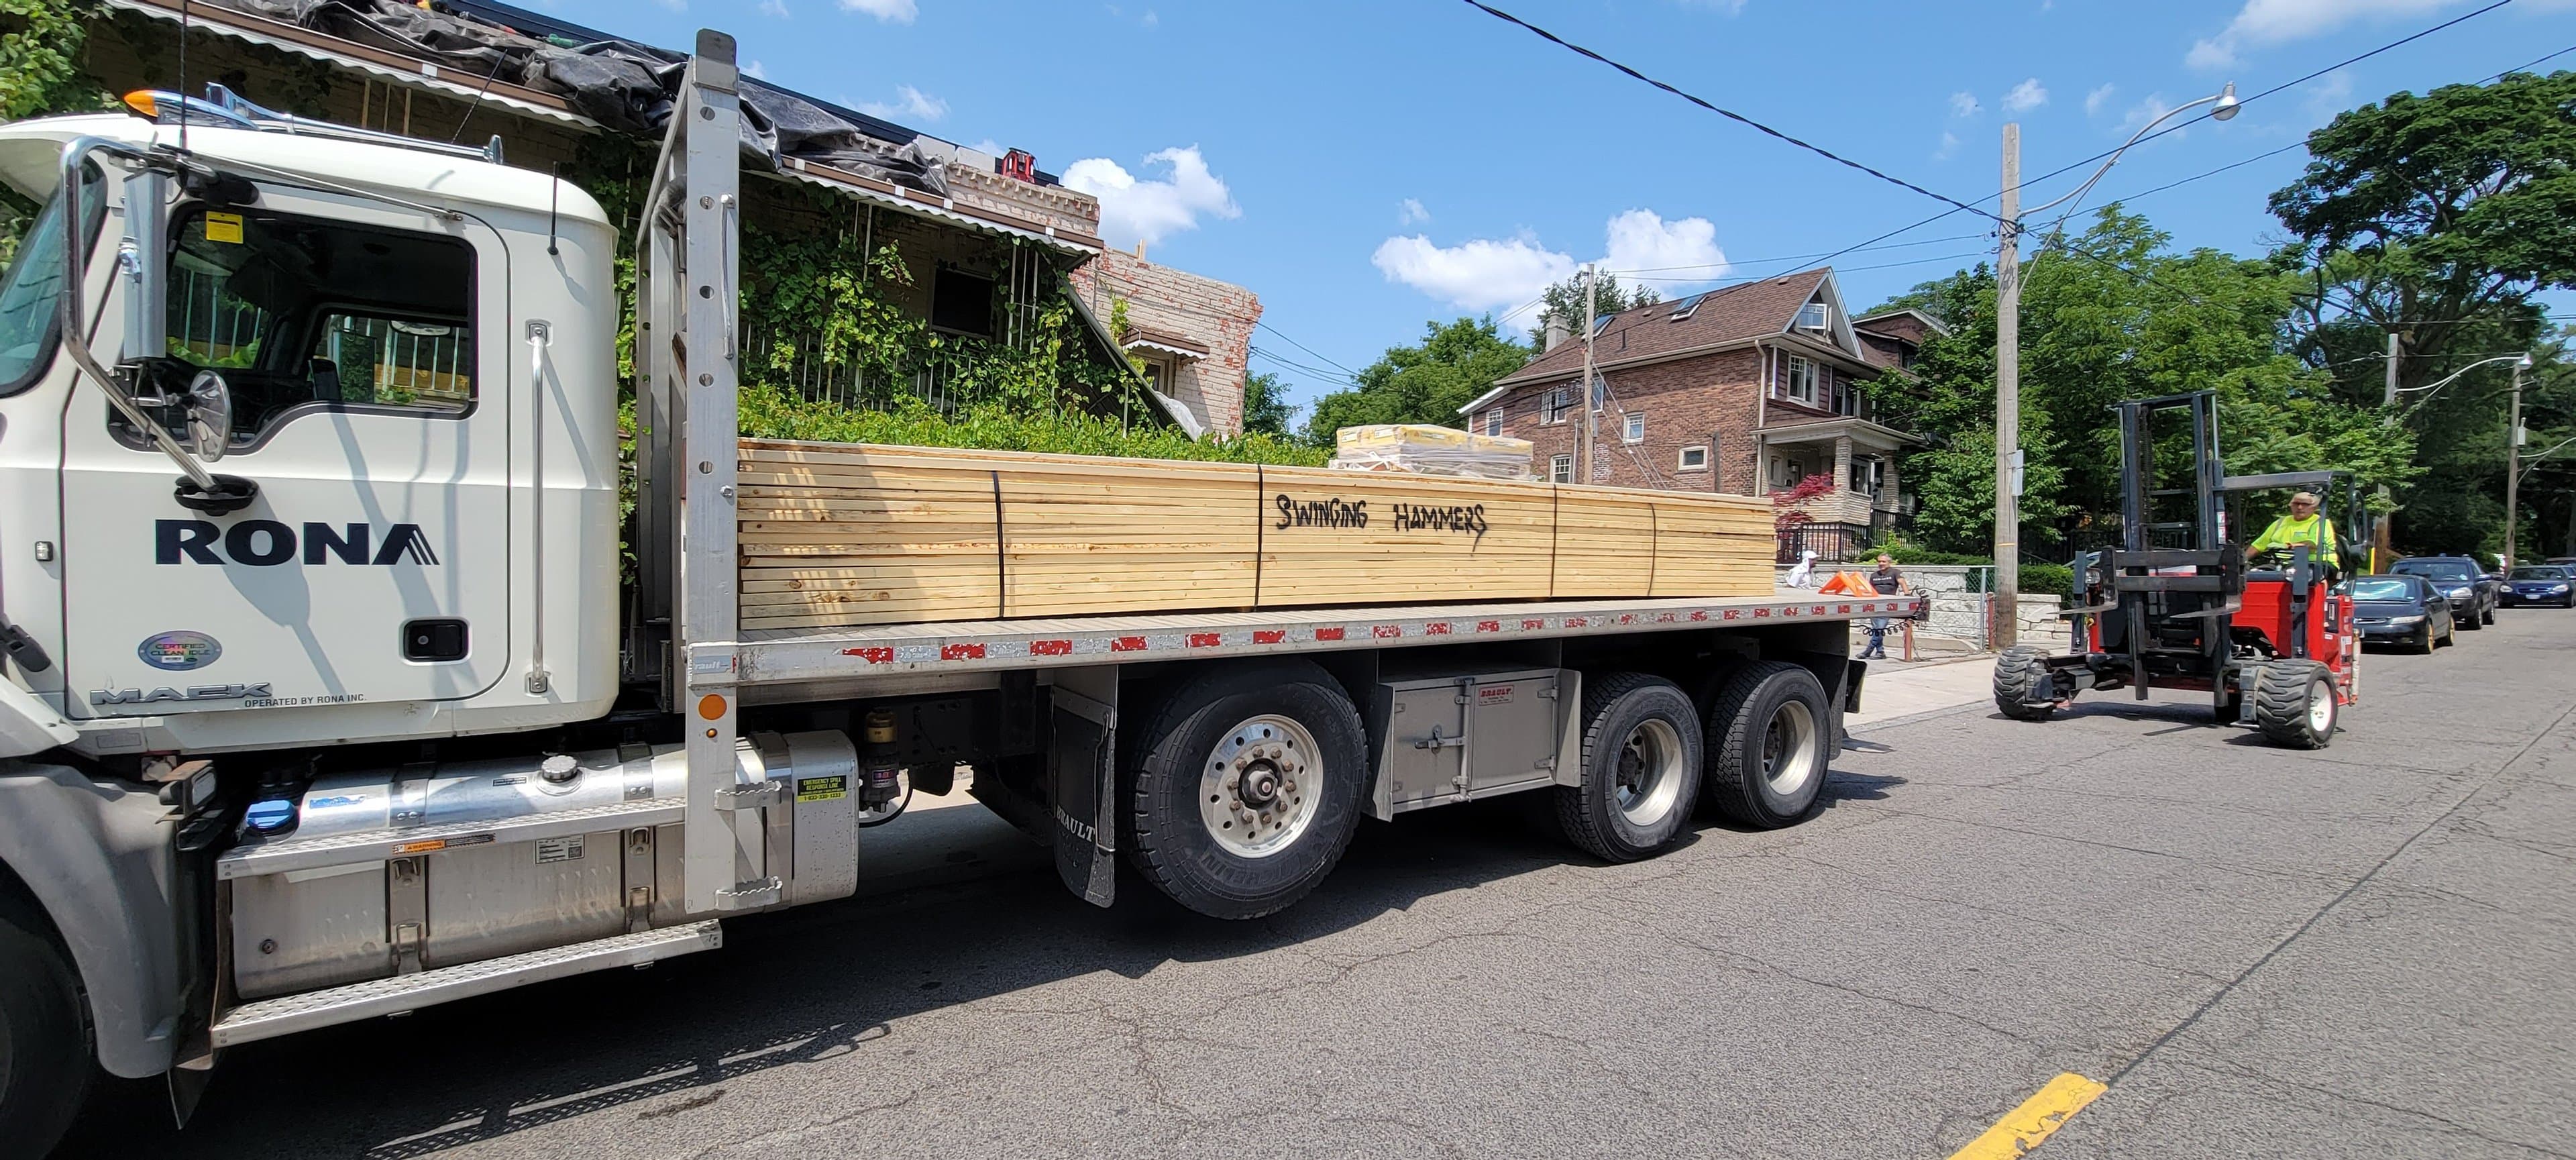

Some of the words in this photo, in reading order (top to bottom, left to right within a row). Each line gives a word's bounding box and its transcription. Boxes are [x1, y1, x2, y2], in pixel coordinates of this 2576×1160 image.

[1276, 494, 1368, 529] SWINGING
[1393, 502, 1487, 552] HAMMERS
[155, 519, 440, 566] RONA
[694, 661, 720, 670] rault
[91, 682, 272, 705] MACK
[244, 696, 297, 708] OPERATED
[301, 696, 316, 704] BY
[317, 694, 344, 704] RONA
[347, 693, 368, 702] INC.
[1057, 804, 1095, 842] BRAULT
